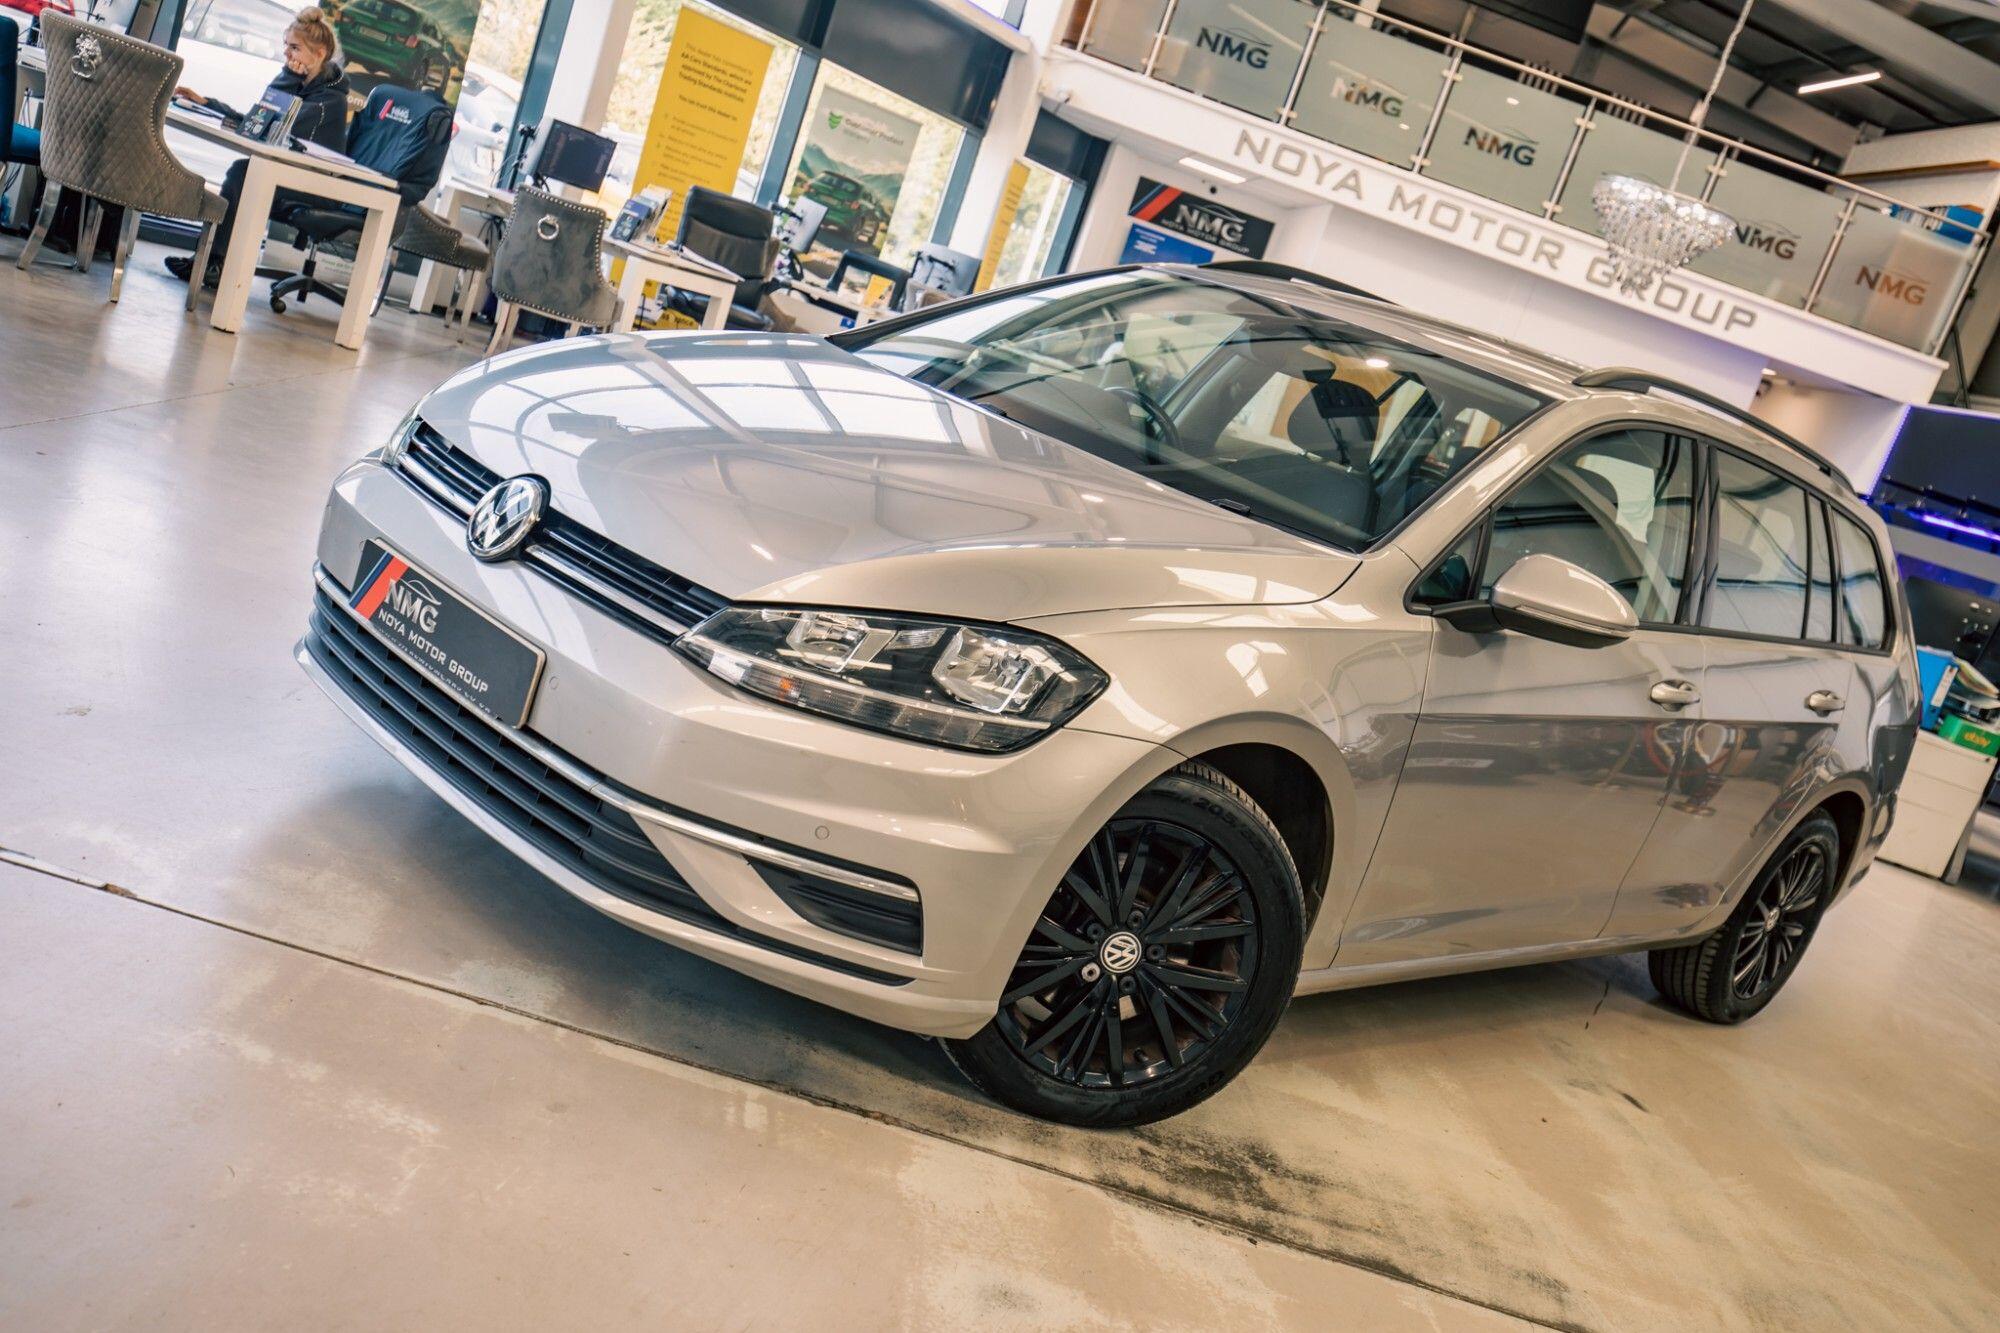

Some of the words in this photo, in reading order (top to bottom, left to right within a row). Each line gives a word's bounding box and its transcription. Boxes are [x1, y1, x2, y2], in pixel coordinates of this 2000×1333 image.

[1196, 26, 1269, 70] NMG
[1463, 126, 1537, 167] NMG
[1234, 128, 1363, 200] NOYA
[1388, 184, 1566, 270] MOTOR
[1175, 204, 1244, 243] NMG
[1186, 227, 1218, 243] MOTOR
[1218, 239, 1250, 254] GROUP
[1735, 225, 1797, 261] NMG
[1856, 265, 1929, 305] NMG
[384, 578, 439, 634] NMG
[378, 608, 405, 637] NOYA
[407, 629, 447, 666] MOTOR
[448, 659, 489, 693] GROUP
